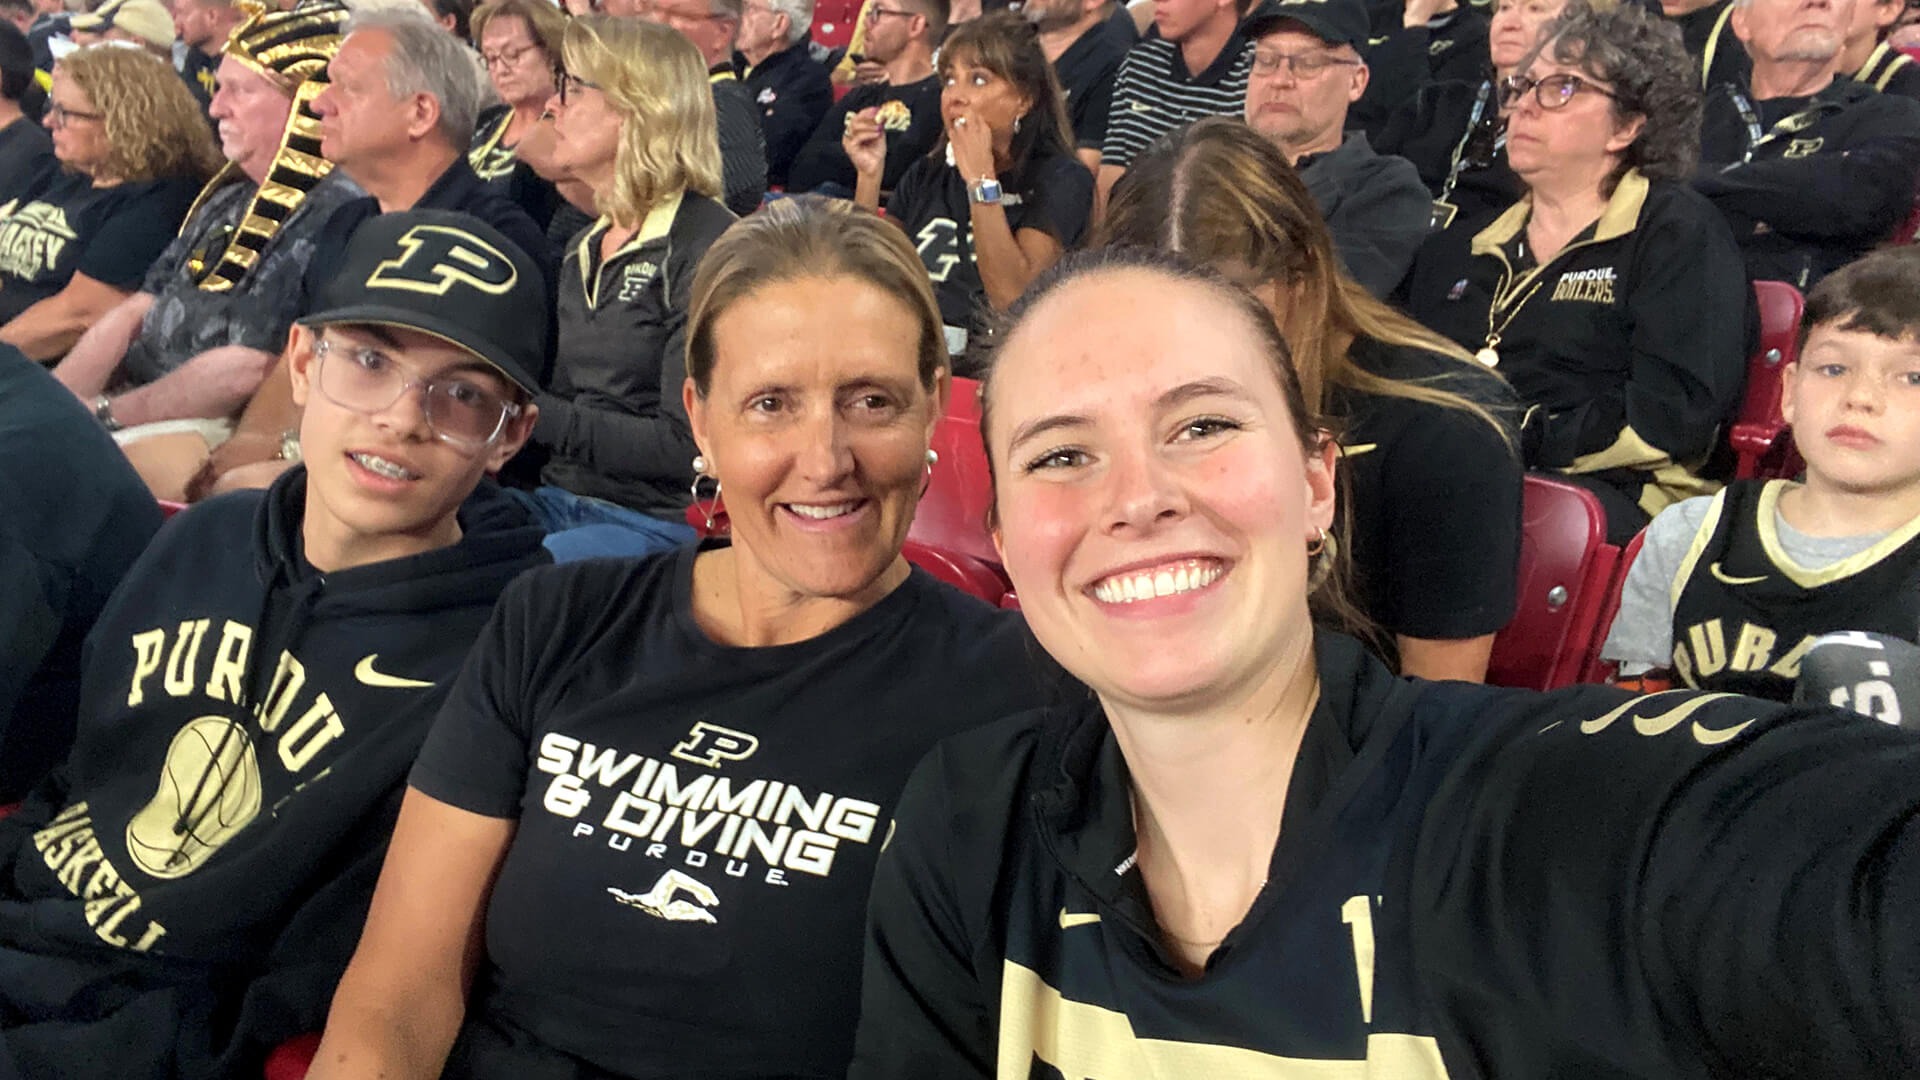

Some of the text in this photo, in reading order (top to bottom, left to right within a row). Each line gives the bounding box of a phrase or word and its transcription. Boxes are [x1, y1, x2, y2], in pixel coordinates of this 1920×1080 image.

[366, 224, 519, 296] P
[128, 618, 345, 800] PURDU
[671, 737, 760, 769] P
[536, 732, 882, 844] SWIMMING
[543, 773, 841, 877] & DIVING
[572, 822, 790, 887] PURDUE
